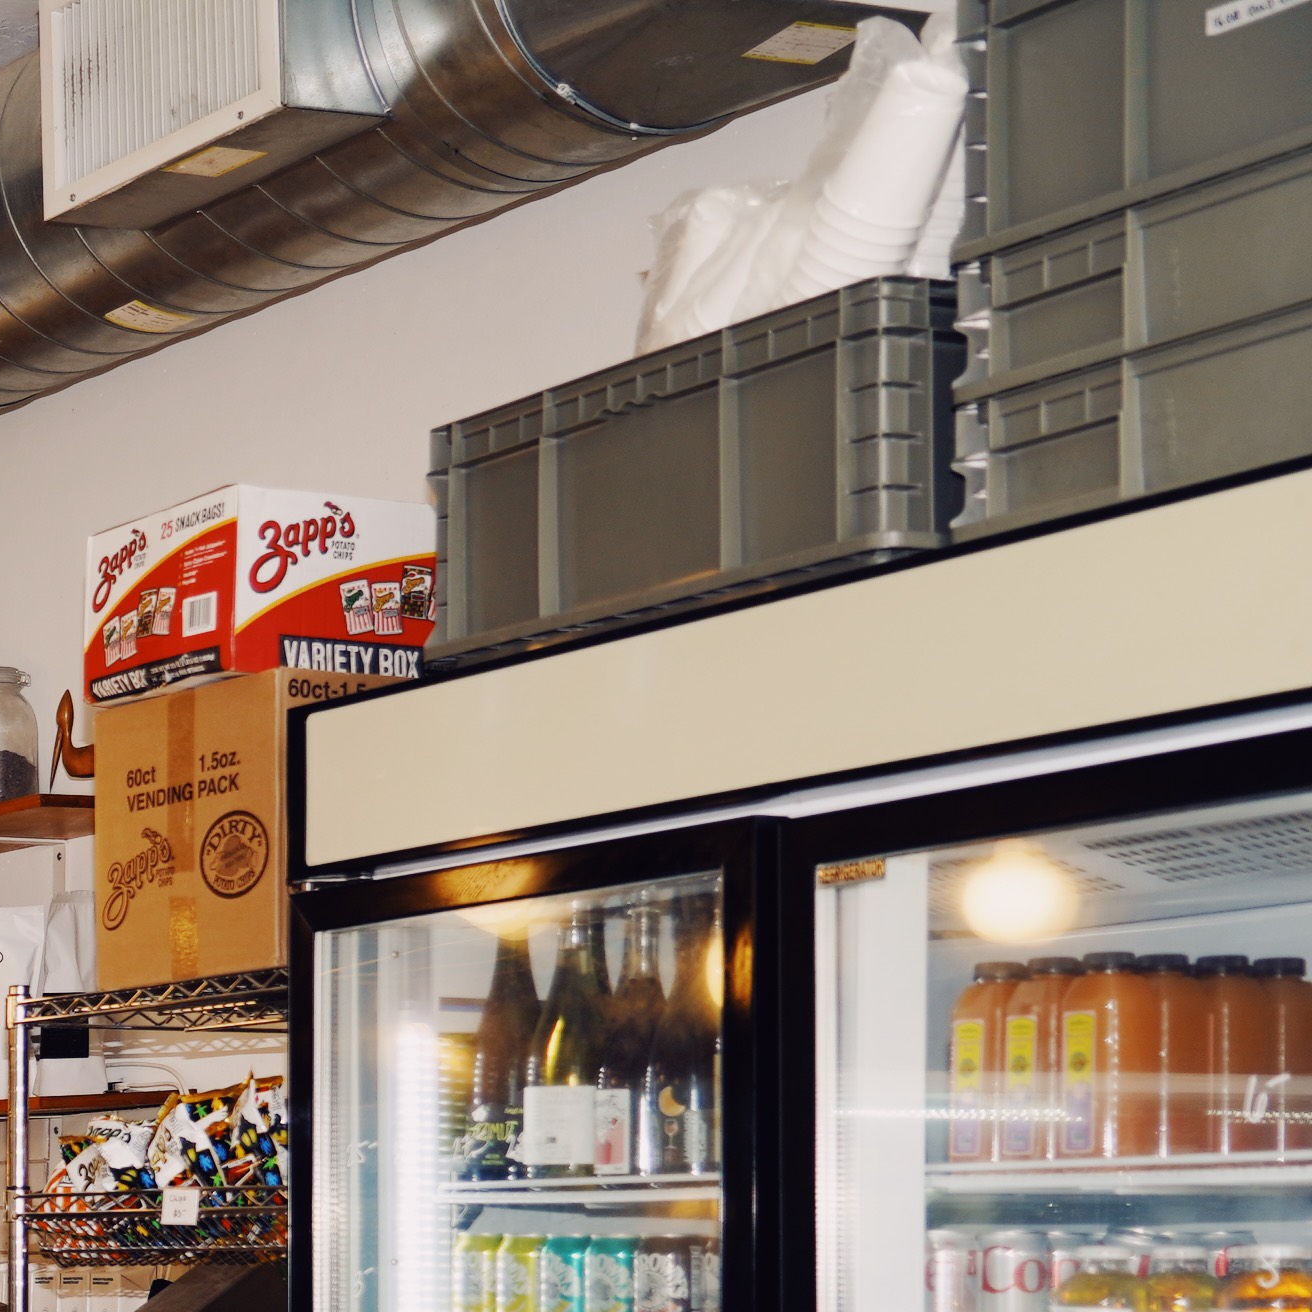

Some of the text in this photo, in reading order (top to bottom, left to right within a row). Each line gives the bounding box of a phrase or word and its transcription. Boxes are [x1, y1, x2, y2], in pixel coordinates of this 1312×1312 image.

[175, 511, 200, 533] SNACK
[333, 551, 354, 561] CHIPS
[283, 640, 420, 679] VARIETY BOX
[127, 766, 156, 788] 60ct
[127, 773, 240, 813] VENDING PACK
